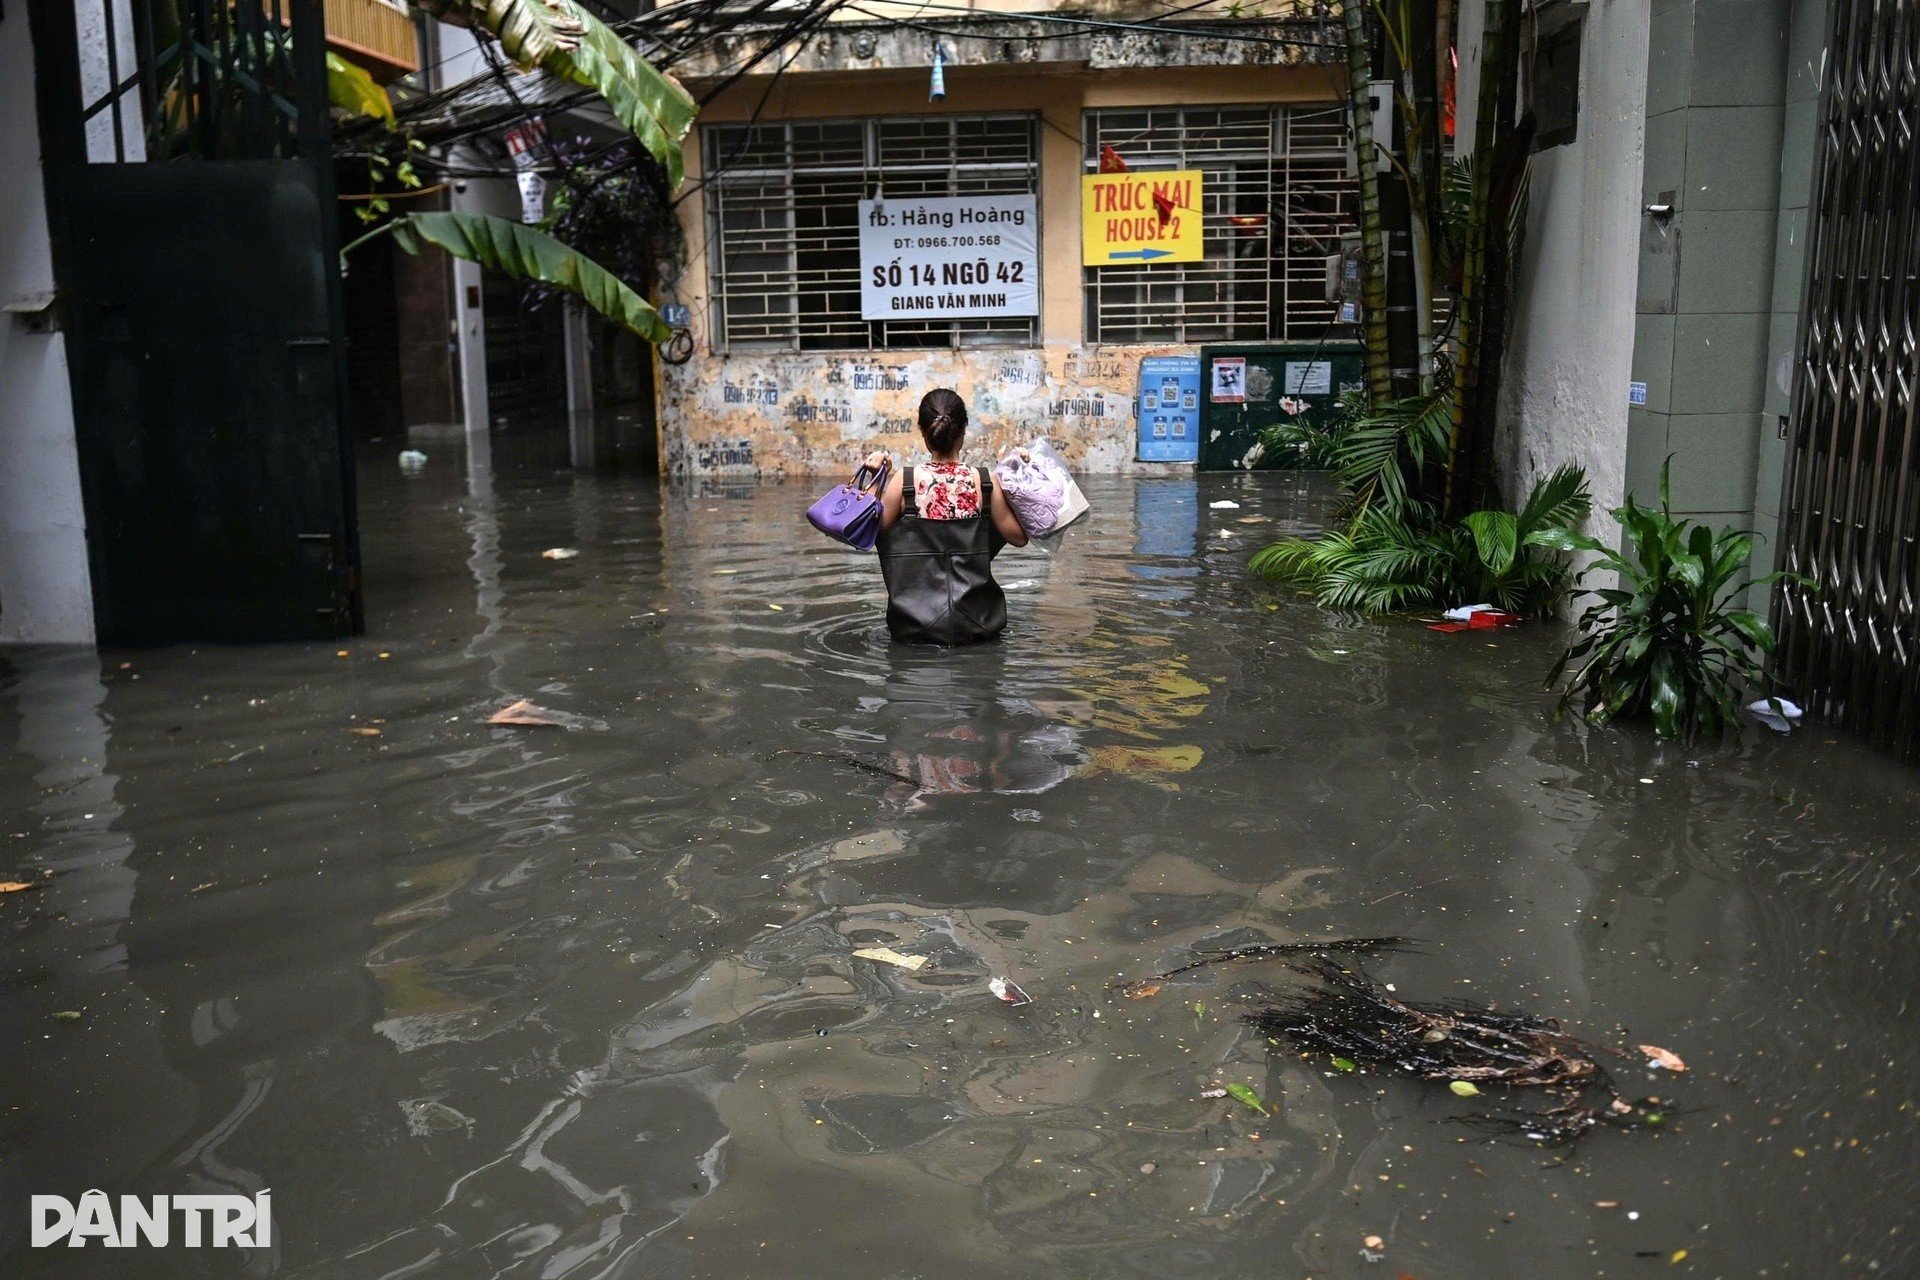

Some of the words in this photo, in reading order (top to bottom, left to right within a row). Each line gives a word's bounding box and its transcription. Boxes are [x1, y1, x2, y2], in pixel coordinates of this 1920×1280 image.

[1093, 176, 1147, 212] TRÚC
[869, 210, 895, 227] fb:
[902, 205, 953, 228] Hằng
[960, 207, 1025, 226] Hoàng
[1171, 215, 1181, 239] 2
[894, 238, 914, 249] ĐT:
[918, 235, 1001, 248] 0966.700.568
[873, 256, 902, 288] SỐ
[909, 263, 936, 286] 14
[943, 257, 989, 285] NGÕ
[996, 260, 1024, 284] 42
[891, 295, 934, 310] GIANG
[937, 292, 968, 309] VĂN
[969, 293, 1006, 308] MINH
